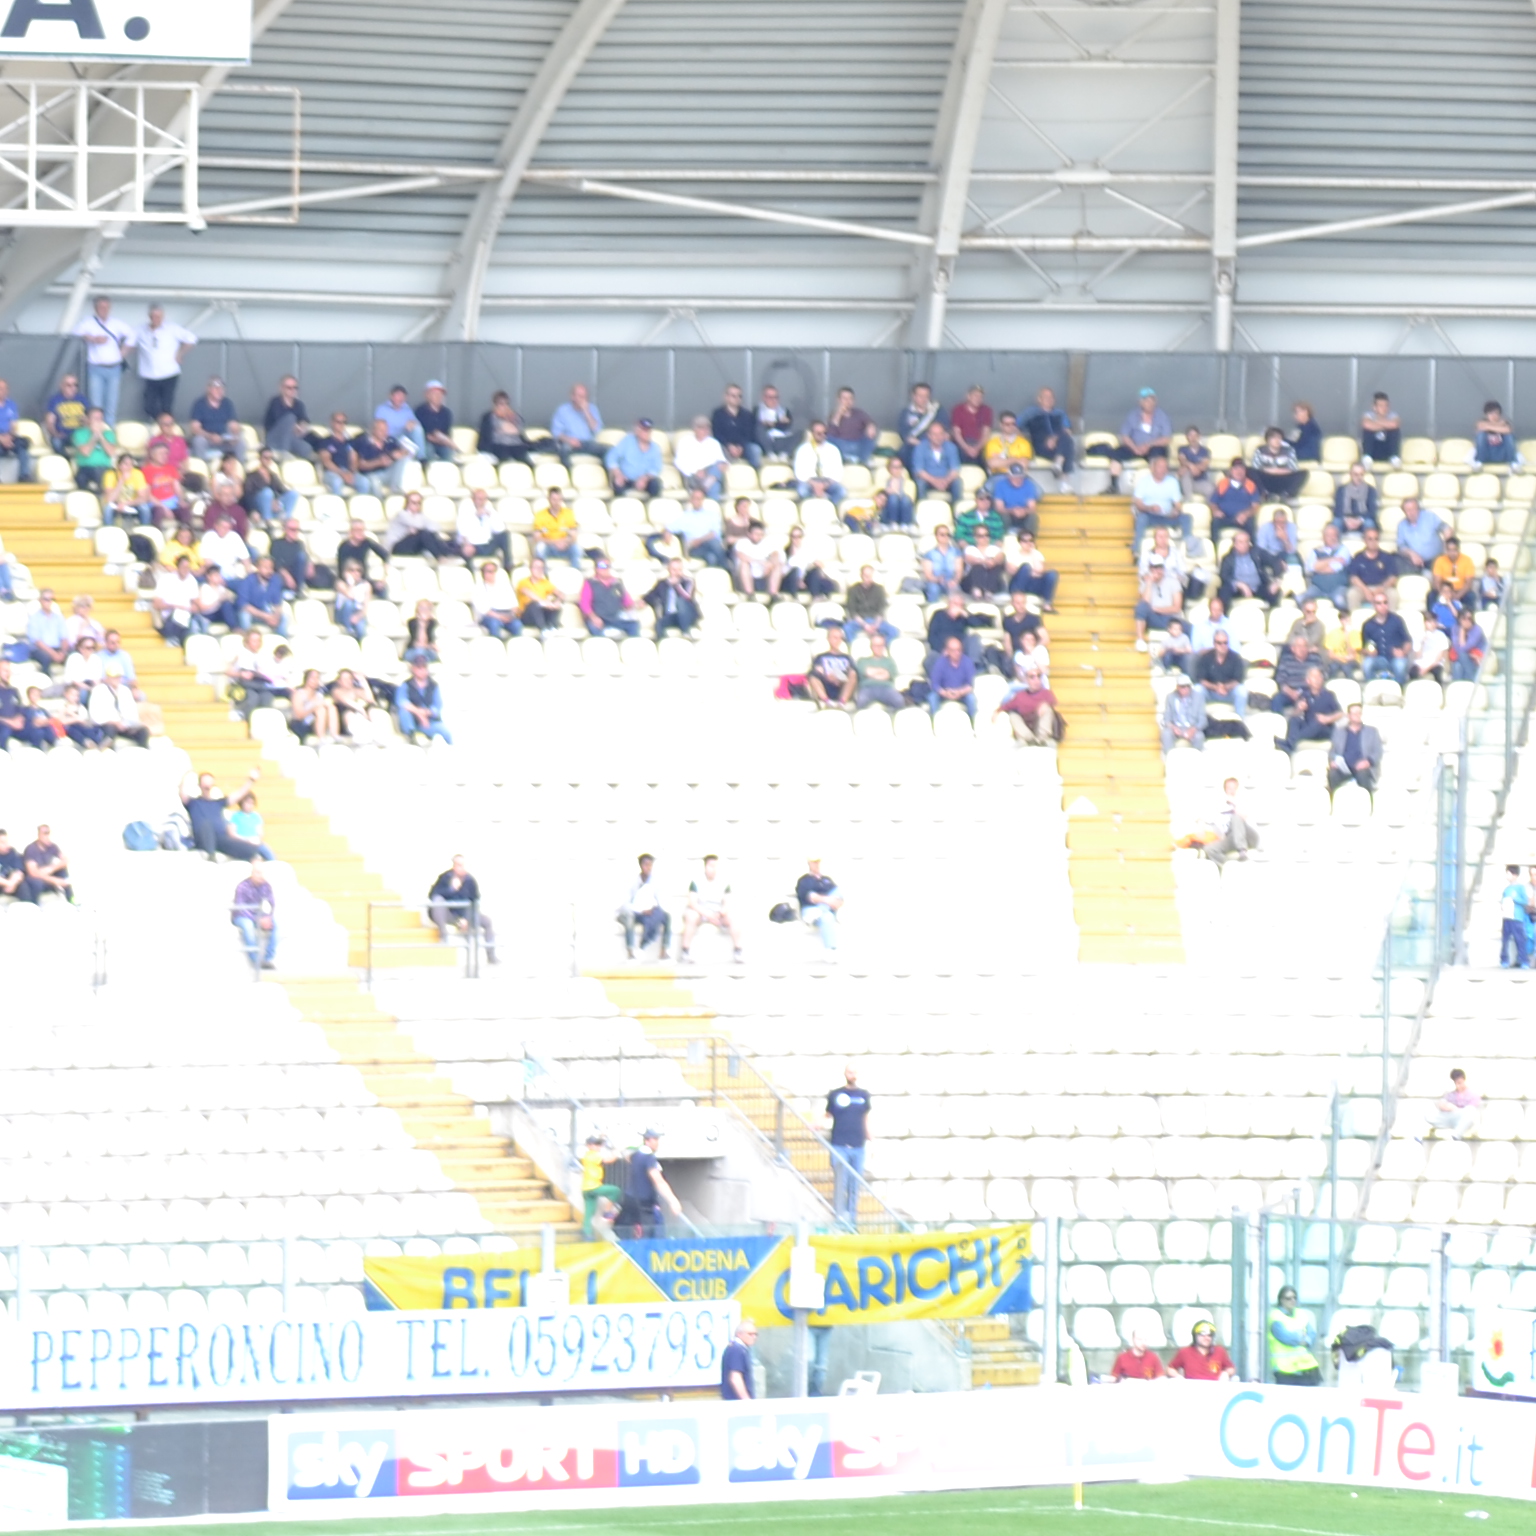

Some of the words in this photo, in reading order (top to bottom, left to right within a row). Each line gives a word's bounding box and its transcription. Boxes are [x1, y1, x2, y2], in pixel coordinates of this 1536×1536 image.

[650, 1249, 750, 1275] MODENA
[673, 1277, 728, 1301] CLUB
[30, 1318, 365, 1393] PEPPERONCINO
[399, 1318, 491, 1383] TEL.
[294, 1430, 388, 1498] sky
[408, 1443, 598, 1490] SPORT
[624, 1429, 697, 1476] HD
[730, 1415, 824, 1481] sky
[1220, 1390, 1484, 1487] ConTe.it
